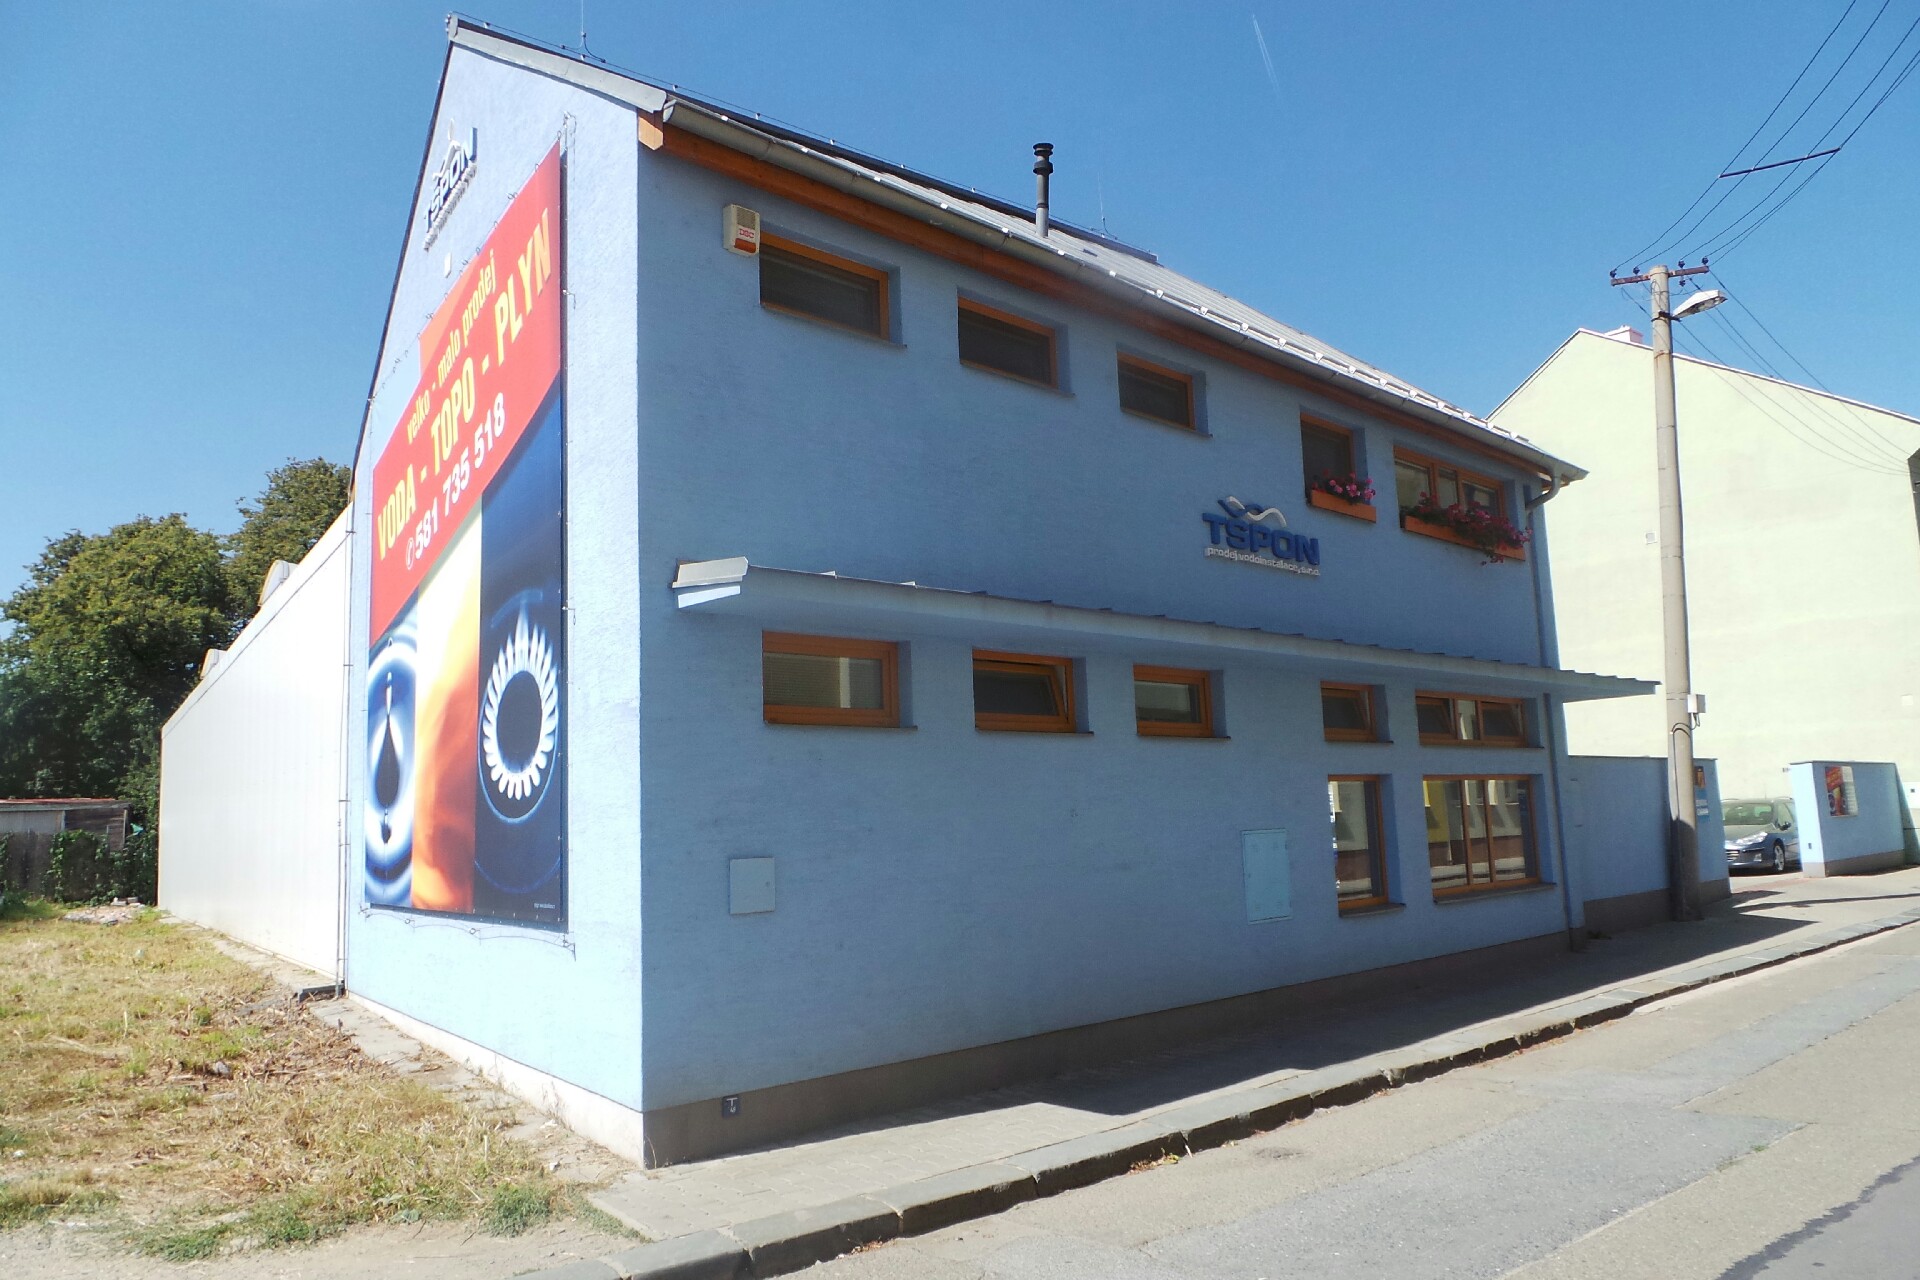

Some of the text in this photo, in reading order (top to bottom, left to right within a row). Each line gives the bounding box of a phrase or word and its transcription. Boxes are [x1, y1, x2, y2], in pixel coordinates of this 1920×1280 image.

[376, 464, 417, 562] VODA
[429, 357, 475, 476] TOPO
[494, 207, 552, 367] PLYN
[406, 389, 430, 446] velko
[437, 329, 461, 388] malo
[461, 247, 496, 347] prodej
[414, 391, 505, 561] 581 735 518
[1202, 512, 1320, 566] TSPON
[1206, 547, 1238, 561] prodej
